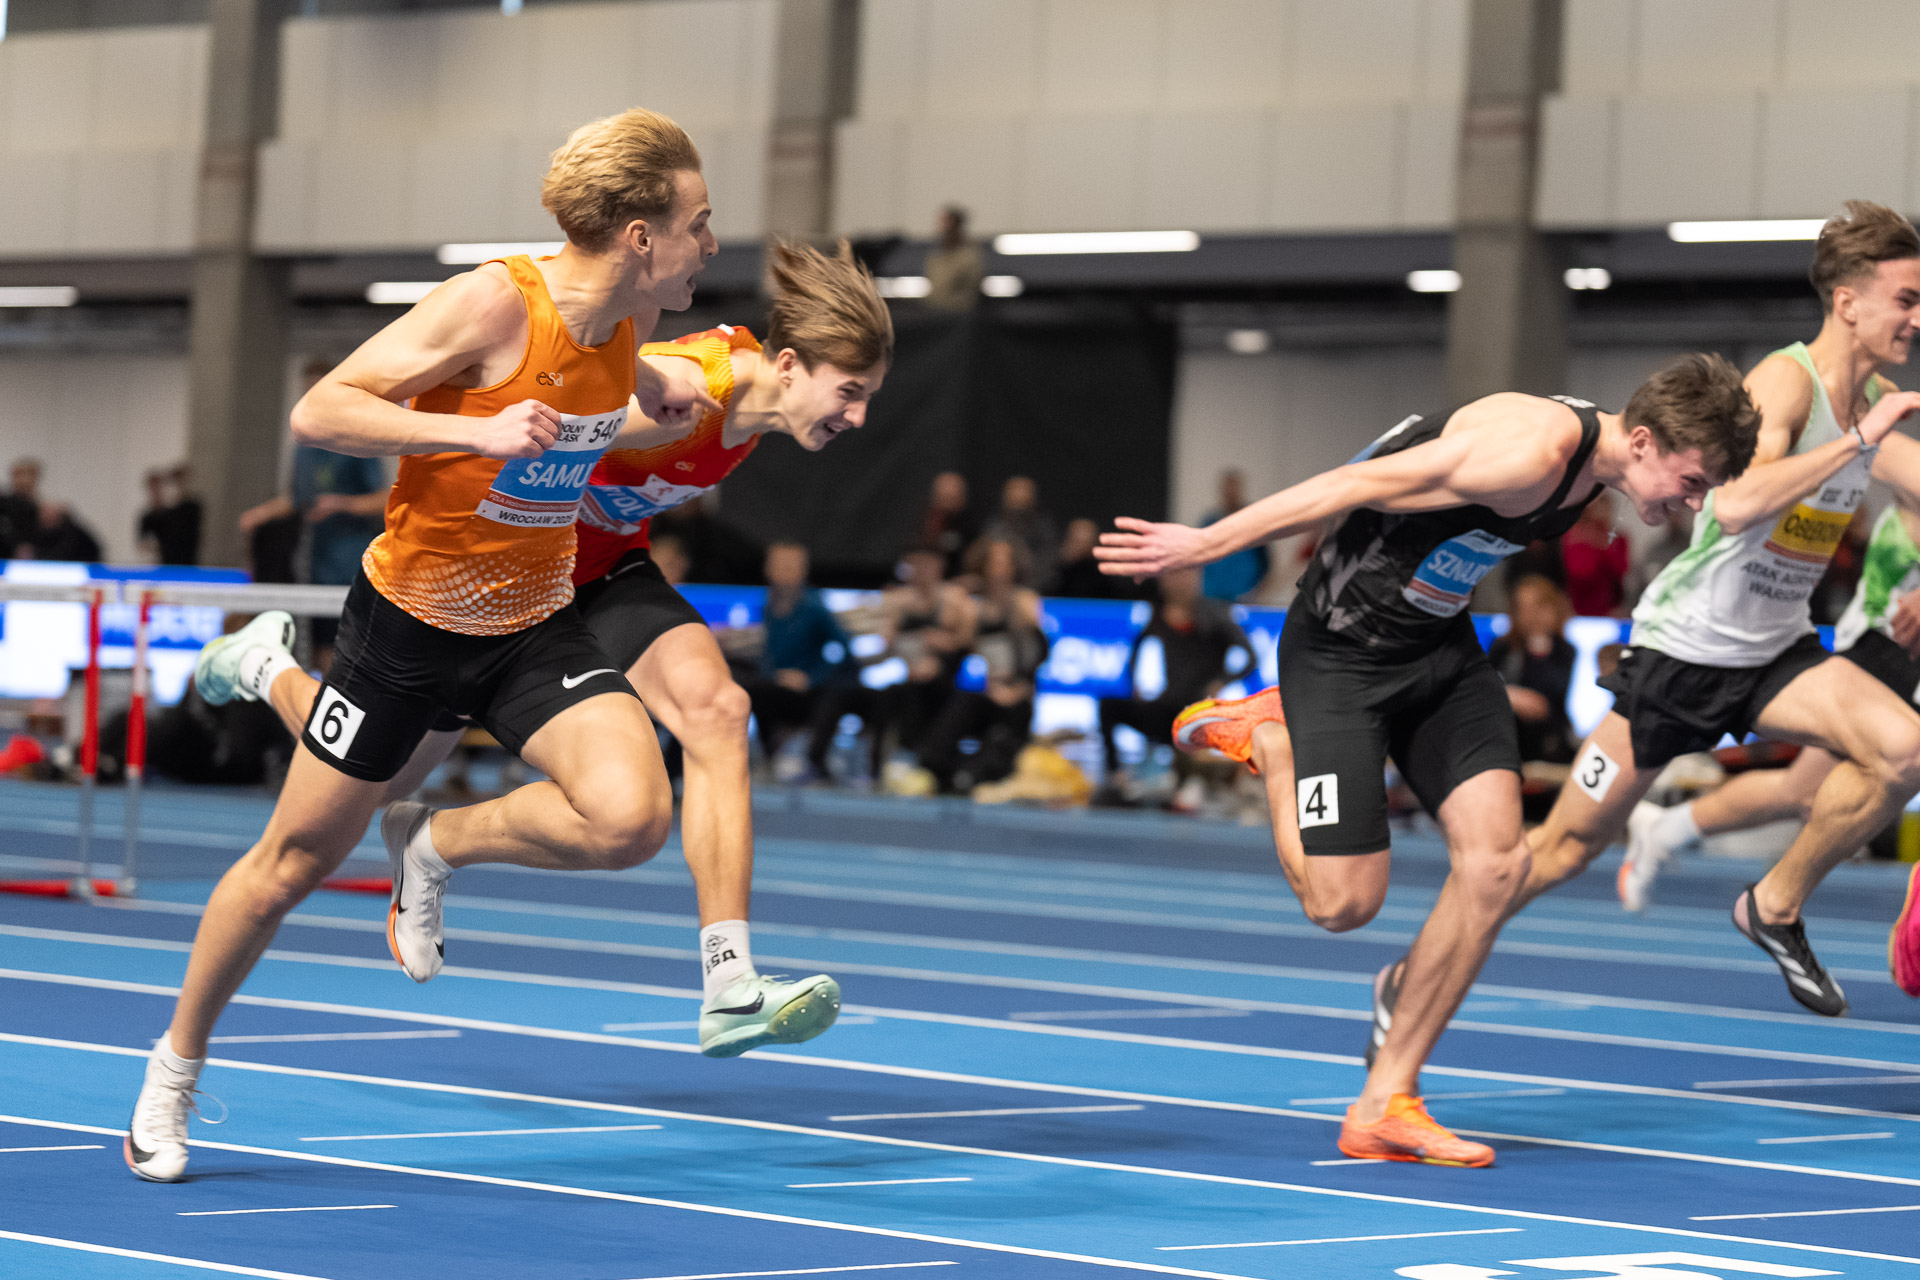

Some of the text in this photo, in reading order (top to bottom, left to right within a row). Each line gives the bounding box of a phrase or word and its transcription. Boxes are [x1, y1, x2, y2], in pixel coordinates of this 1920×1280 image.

[536, 371, 564, 387] esa
[321, 700, 349, 745] 6
[1582, 756, 1606, 789] 3
[1305, 781, 1328, 820] 4
